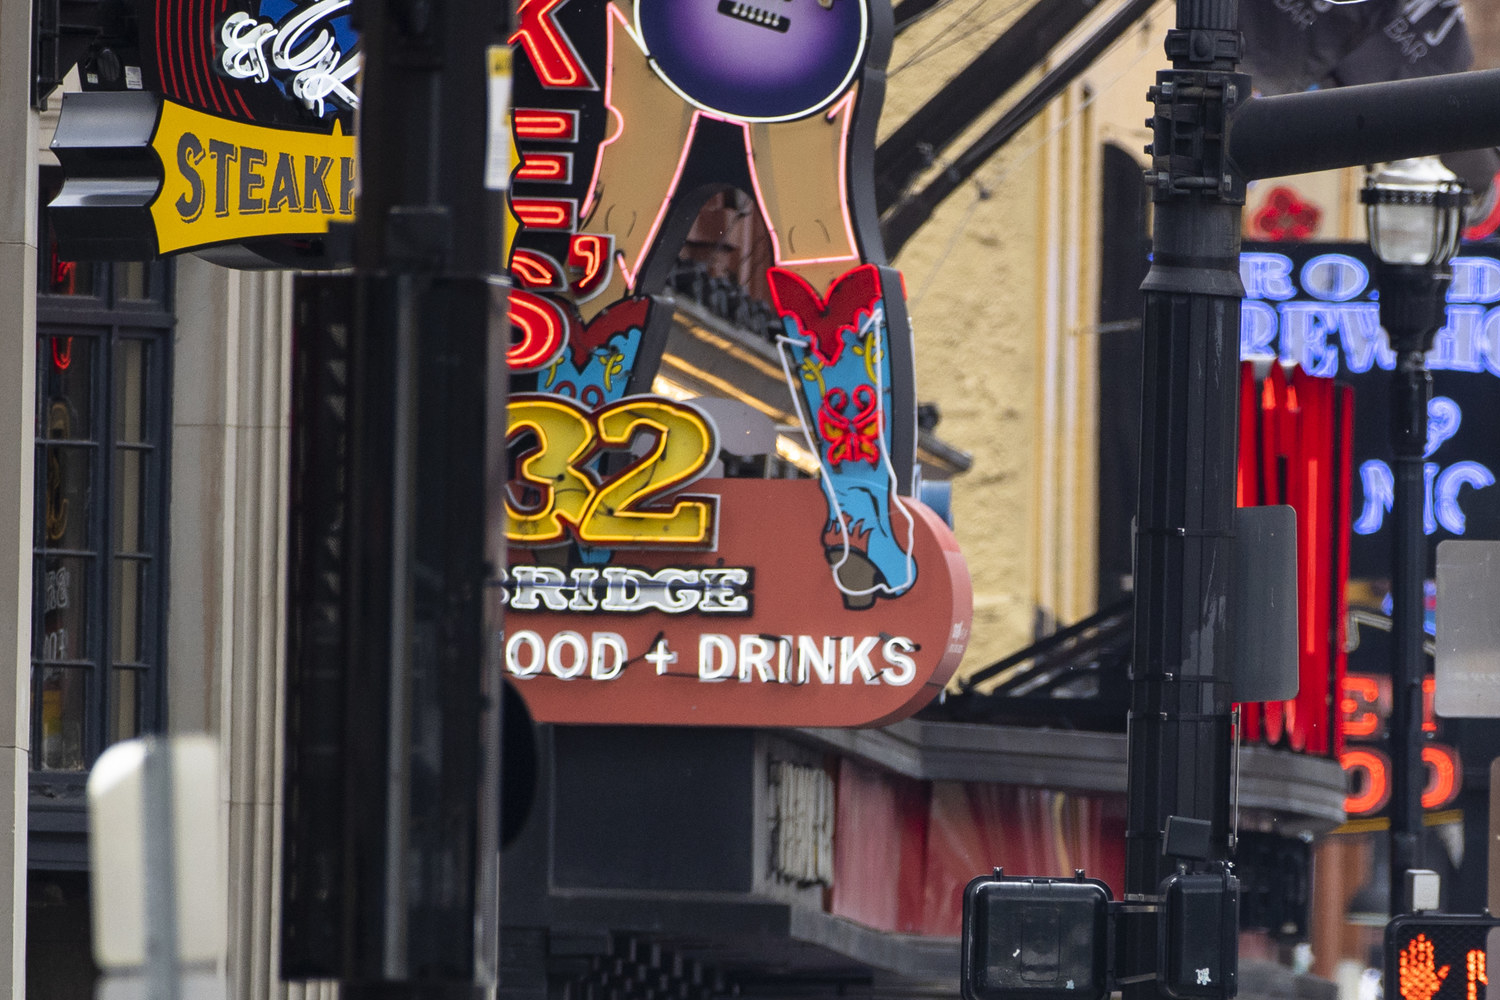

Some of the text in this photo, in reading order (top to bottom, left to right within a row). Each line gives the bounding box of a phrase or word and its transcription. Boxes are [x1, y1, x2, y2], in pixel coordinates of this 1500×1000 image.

[505, 394, 720, 550] 32
[501, 566, 749, 613] RIDGE
[502, 630, 628, 681] OOD
[699, 633, 918, 687] DRINKS
